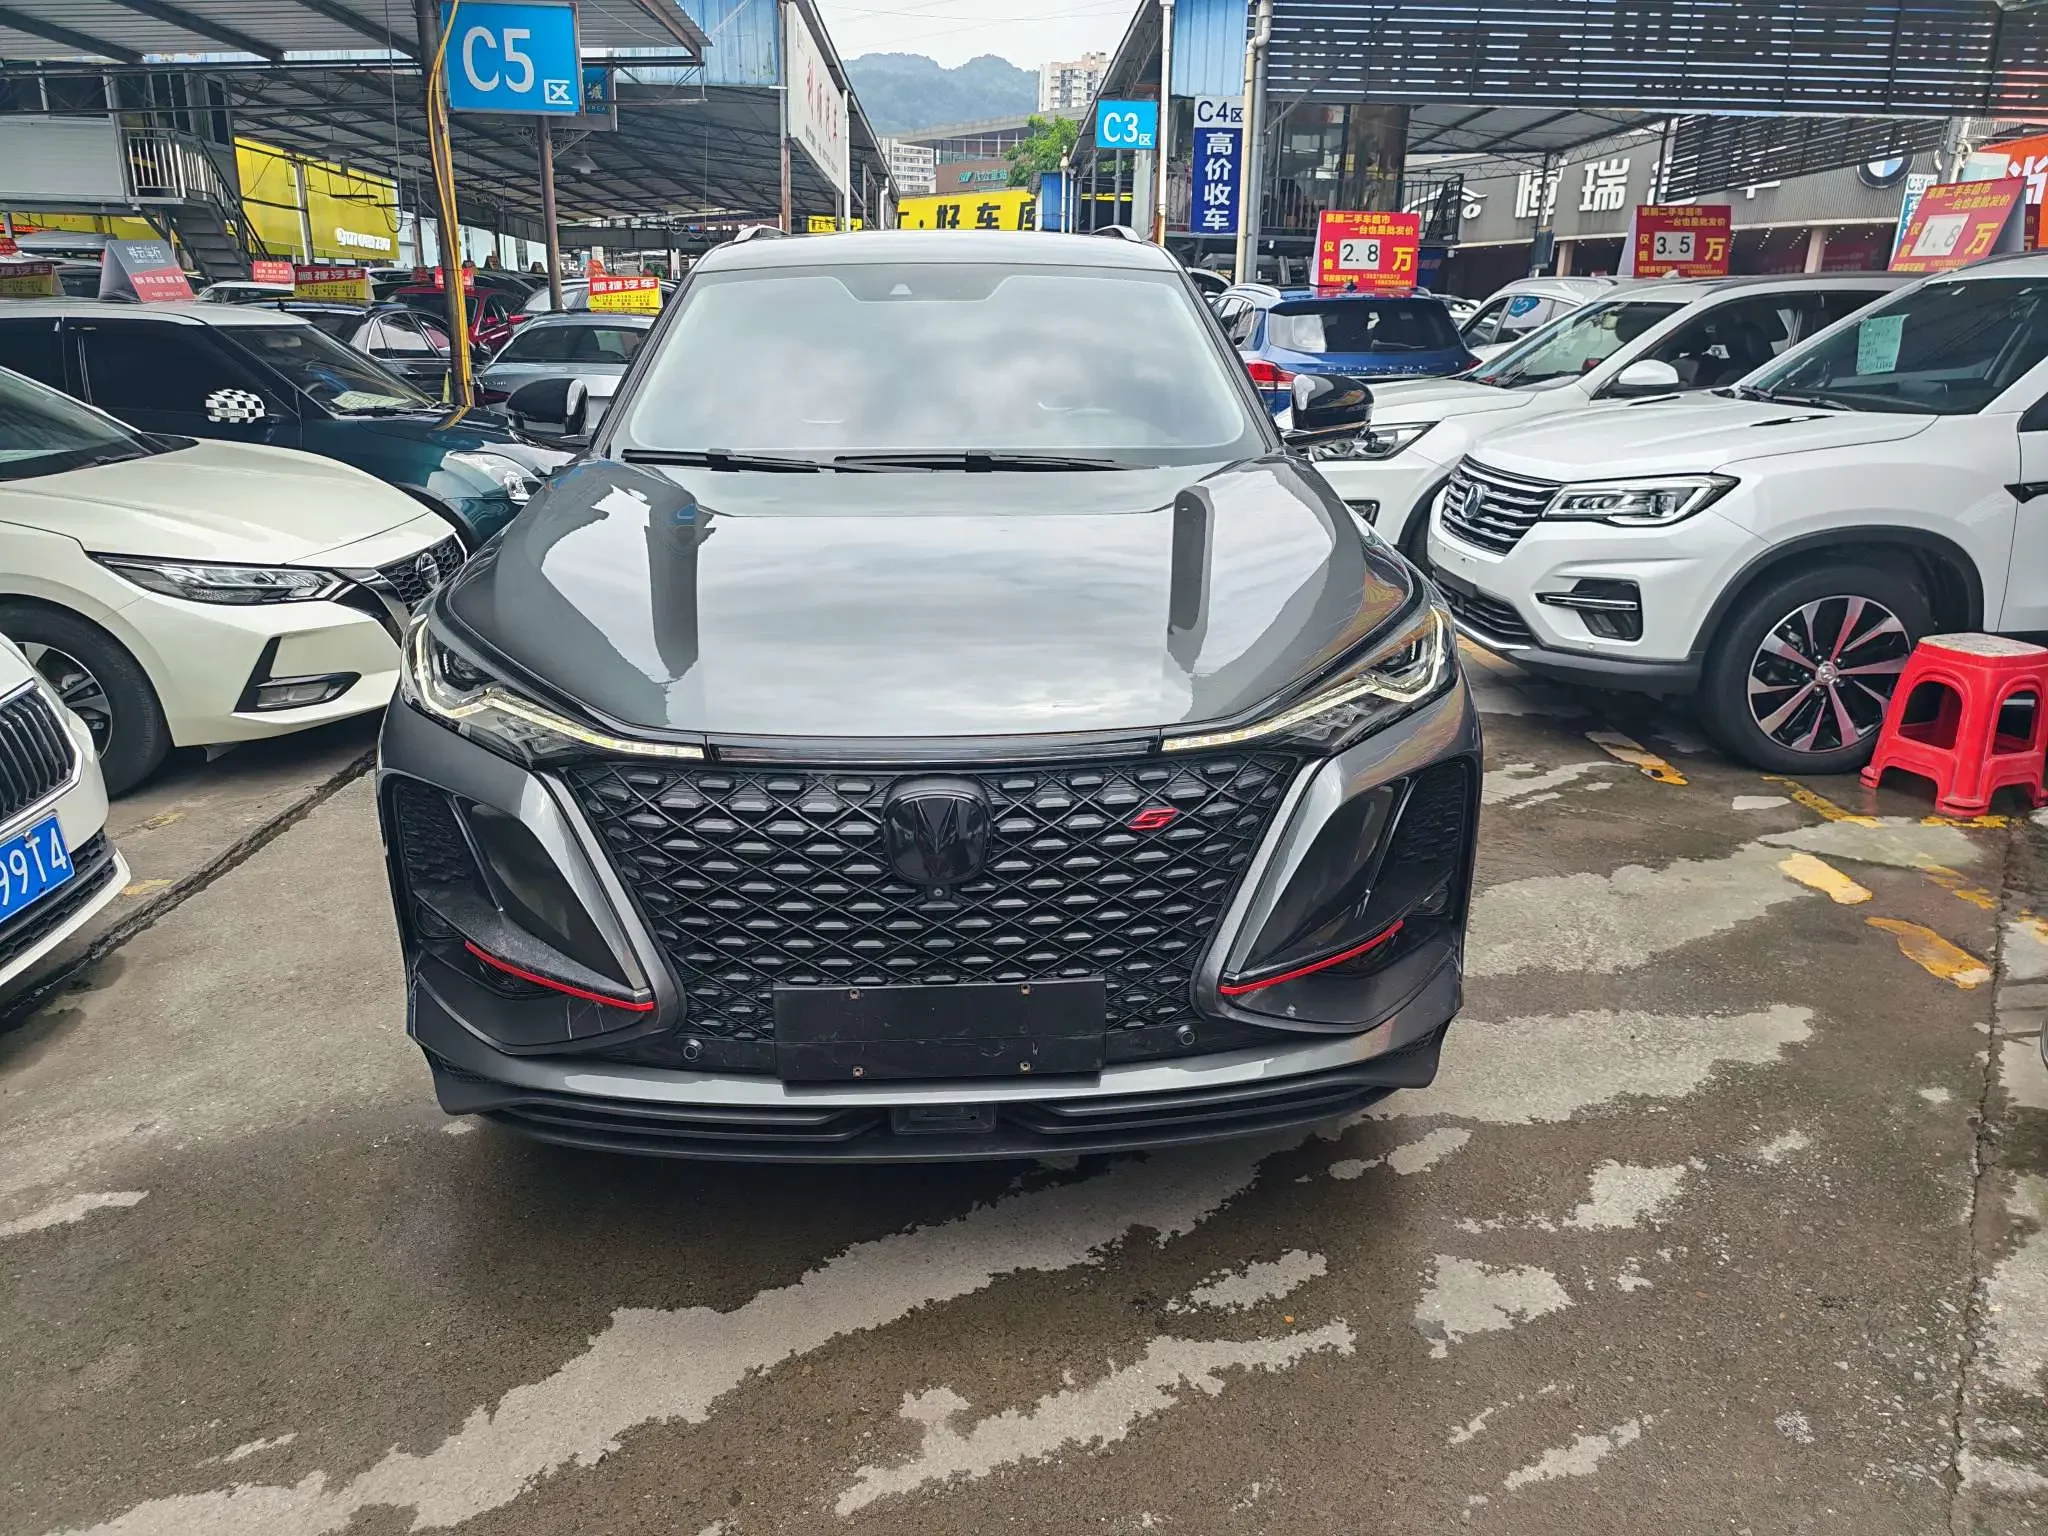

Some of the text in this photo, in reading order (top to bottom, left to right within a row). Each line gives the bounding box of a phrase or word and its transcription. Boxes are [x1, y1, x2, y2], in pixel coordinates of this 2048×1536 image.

[462, 26, 573, 105] C5 区
[1197, 100, 1244, 123] C4 区
[1103, 112, 1152, 146] C3 区
[1202, 132, 1234, 230] 高价收车
[1349, 225, 1414, 236] 一台也是批发价
[1920, 224, 1962, 249] 1.8
[1963, 222, 1999, 255] 万
[1342, 243, 1379, 262] 2.8
[1392, 246, 1415, 271] 万
[1656, 236, 1691, 255] 3.5
[1704, 237, 1726, 261] 万
[592, 279, 657, 293] 顺捷汽车
